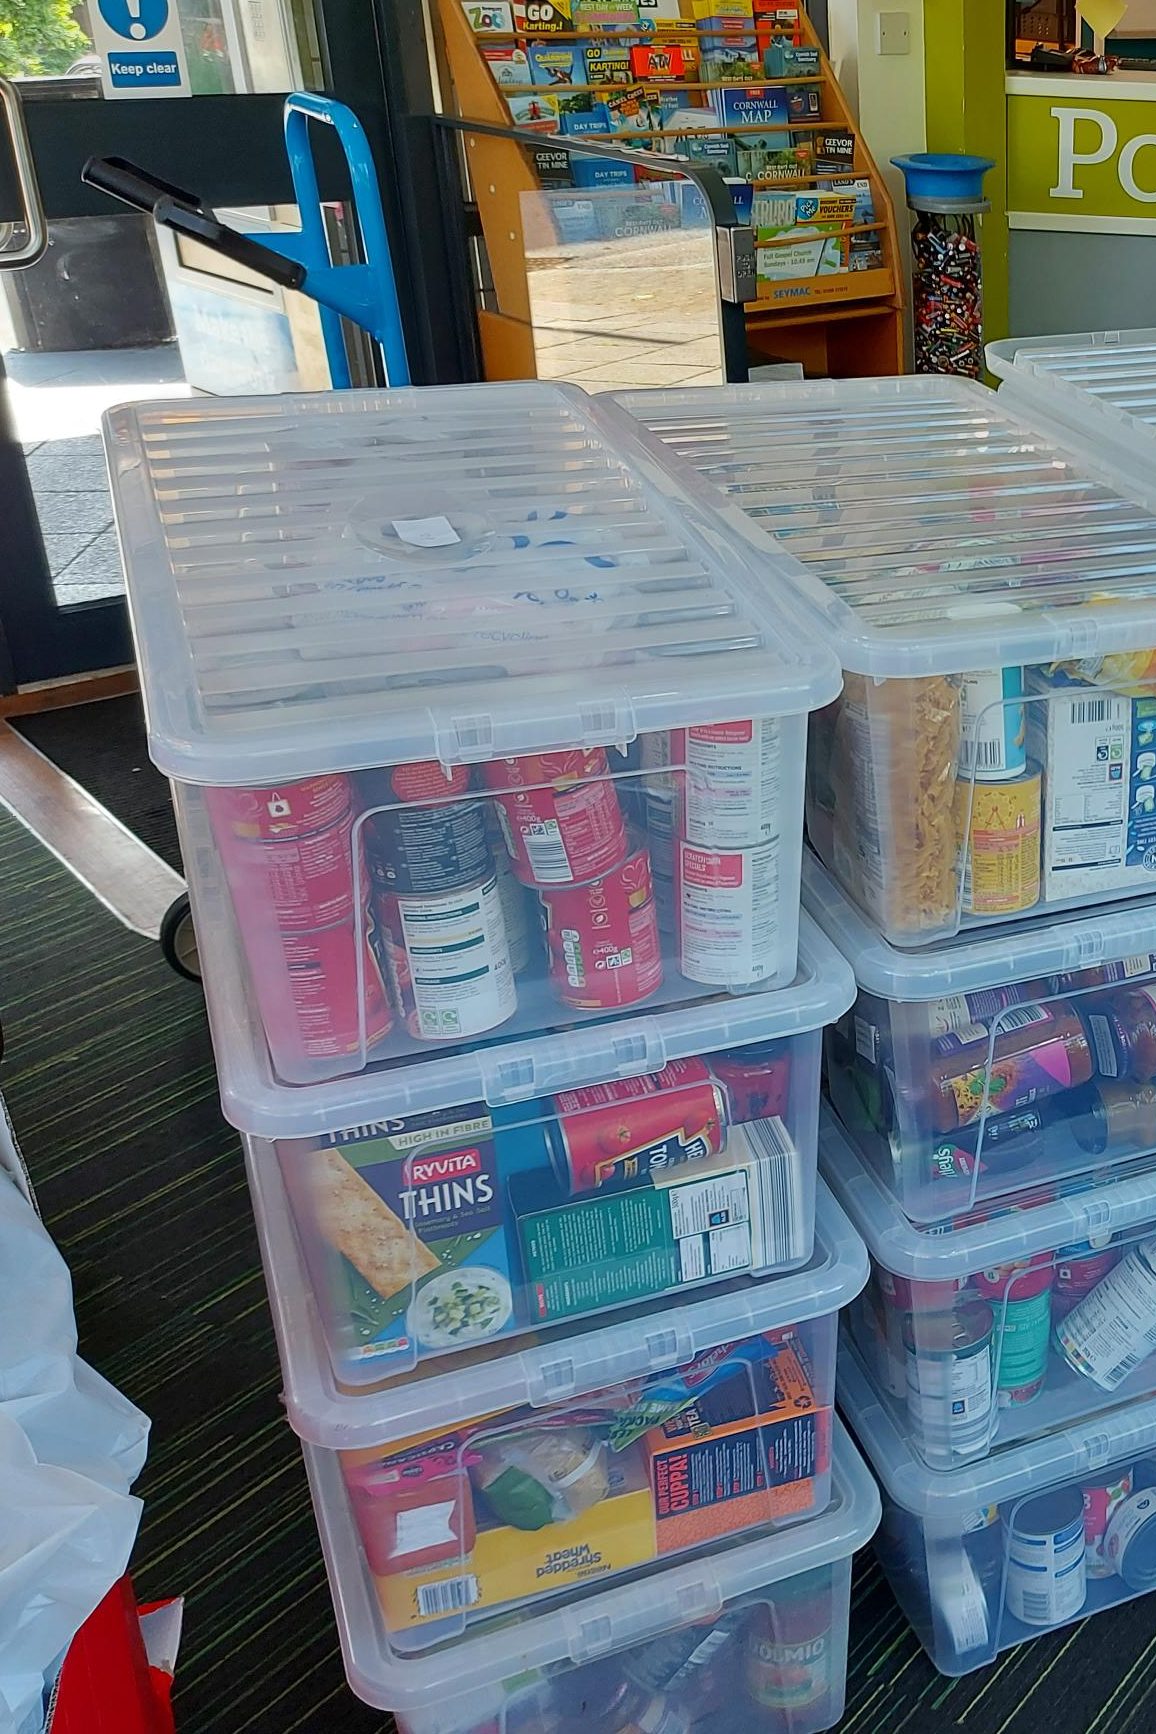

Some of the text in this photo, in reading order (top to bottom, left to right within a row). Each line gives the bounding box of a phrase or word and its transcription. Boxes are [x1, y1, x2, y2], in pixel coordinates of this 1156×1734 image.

[527, 4, 554, 21] GO
[587, 49, 600, 57] GO
[111, 62, 177, 77] Keep clear
[590, 61, 629, 72] KARTING!
[733, 100, 778, 111] CORNWALL
[741, 110, 772, 124] MAP
[574, 122, 608, 131] DAY TRIPS
[824, 138, 853, 148] GEEVOR
[535, 152, 568, 162] GEEVOR
[551, 161, 569, 169] MINE
[609, 170, 628, 178] TRIPS
[757, 169, 805, 181] CORNWALL
[819, 204, 854, 213] VOUCHERS
[763, 252, 773, 260] Full
[773, 287, 811, 299] SEYMAC
[327, 1116, 405, 1144] THINS
[398, 1119, 489, 1148] HIGH IN FIBRE
[398, 1174, 493, 1220] THINS
[656, 1459, 669, 1494] PERFECT
[669, 1453, 690, 1511] CUPPA!
[544, 1543, 591, 1565] wheat
[535, 1551, 602, 1578] shredded
